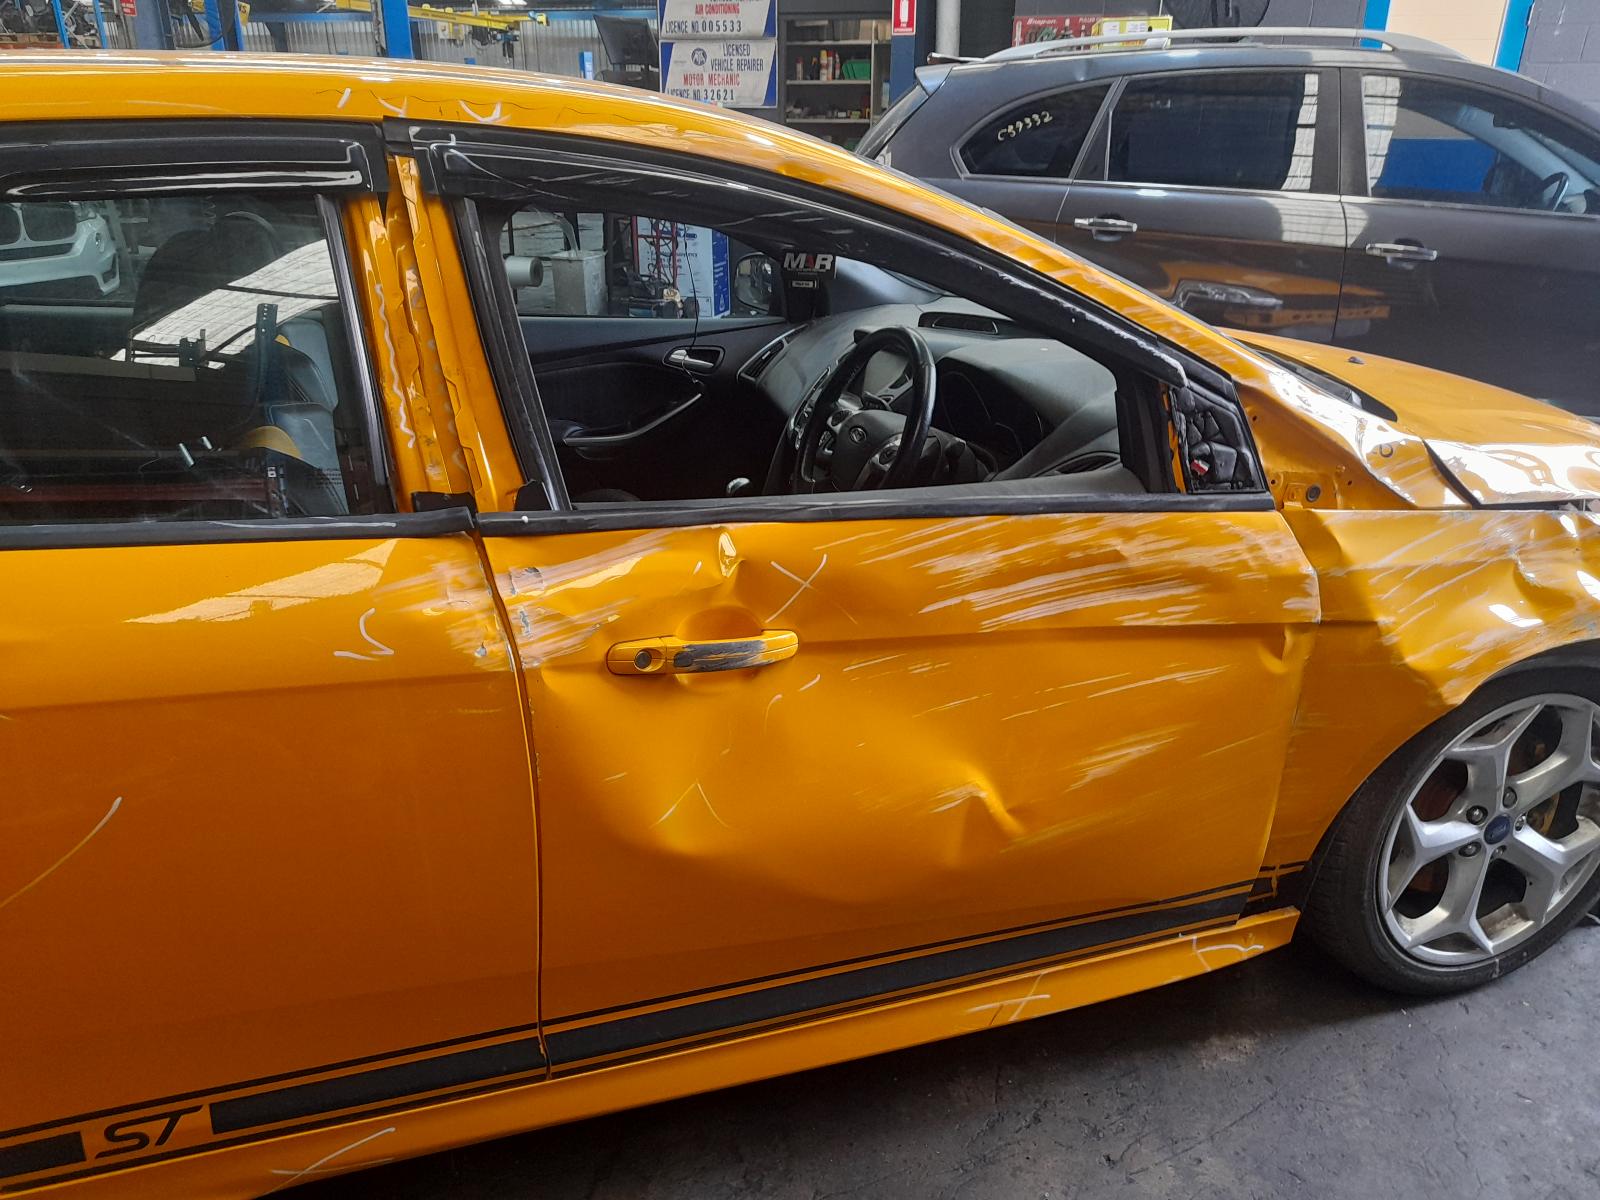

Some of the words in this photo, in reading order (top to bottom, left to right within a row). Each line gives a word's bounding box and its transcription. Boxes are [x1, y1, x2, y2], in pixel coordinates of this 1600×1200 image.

[695, 3, 704, 15] AIR
[705, 3, 740, 15] CONDITIONING
[665, 20, 689, 34] LICENCE
[701, 20, 742, 33] 005533
[722, 43, 751, 57] LICENSED
[710, 58, 734, 72] VEHICLE
[736, 58, 764, 72] REPAIRER
[683, 73, 705, 87] MOTOR
[708, 73, 741, 87] MECHANIC
[703, 88, 734, 101] 32621
[95, 1104, 204, 1160] ST
